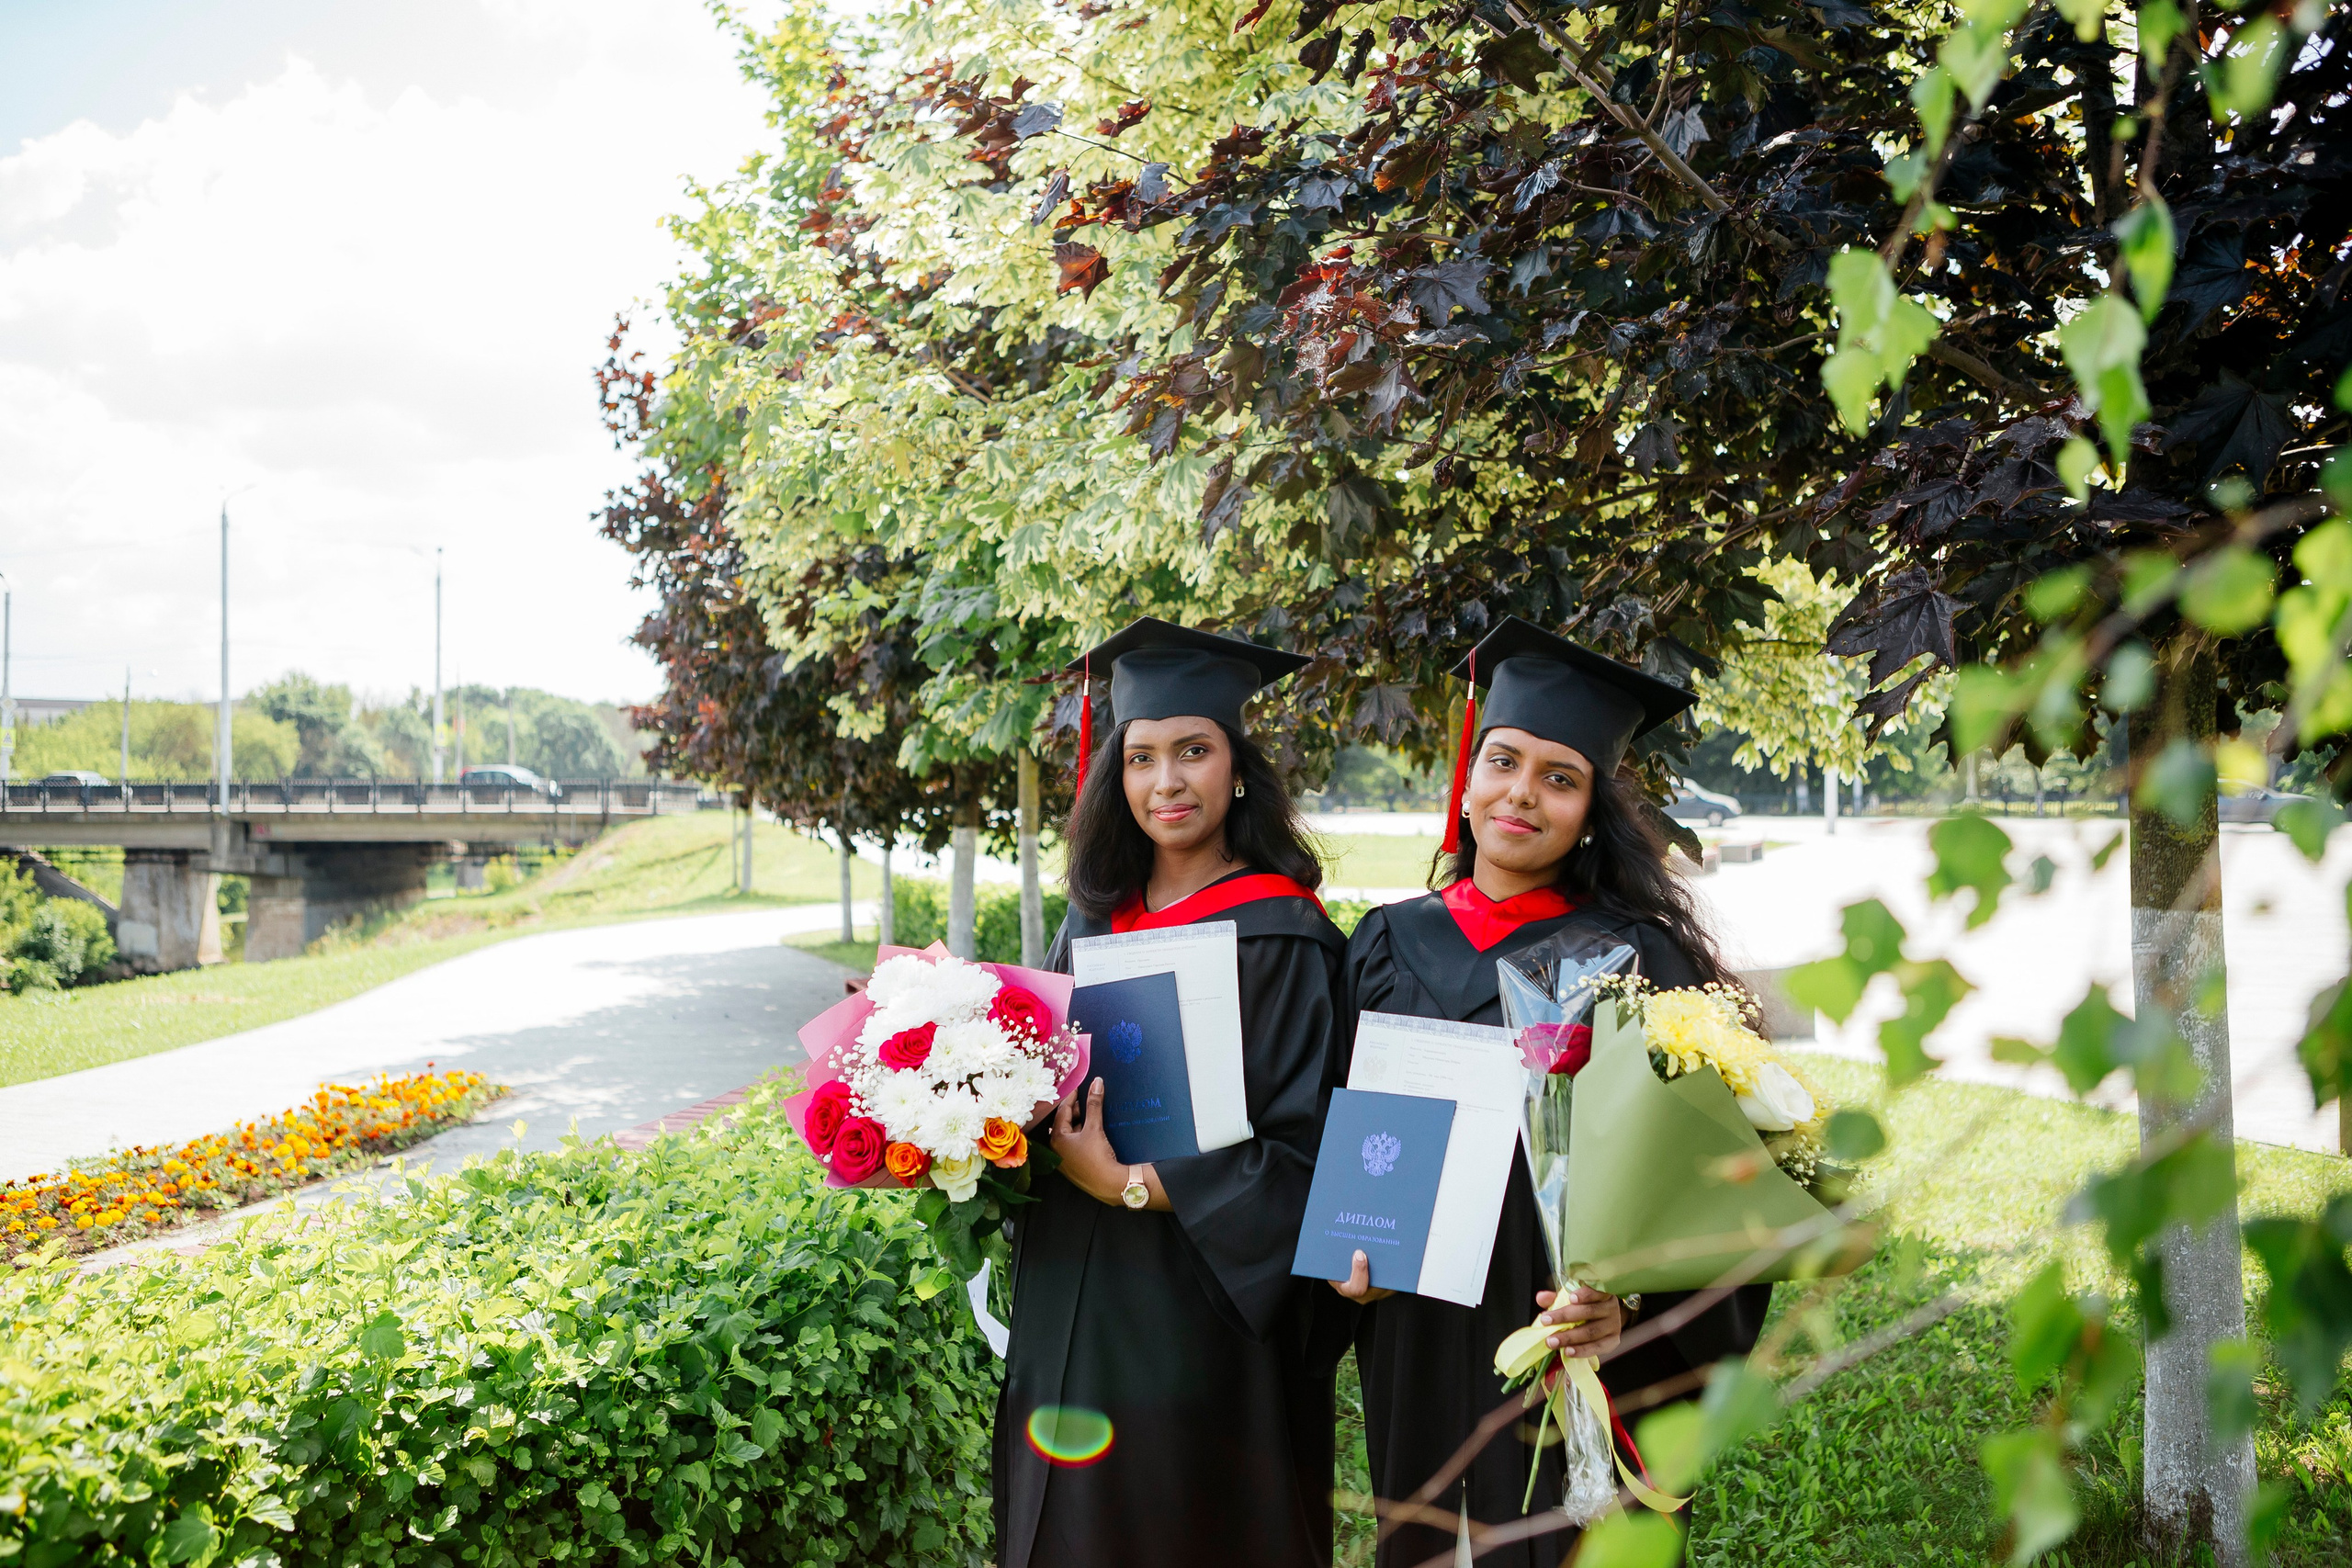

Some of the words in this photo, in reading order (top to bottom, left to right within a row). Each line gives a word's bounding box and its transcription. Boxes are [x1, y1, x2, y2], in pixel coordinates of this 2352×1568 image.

[1335, 1212, 1396, 1230] ДИПЛОМ
[1330, 1230, 1356, 1240] ВЫСШЕМ
[1357, 1235, 1400, 1246] ОБРАЗОВАНИИ
